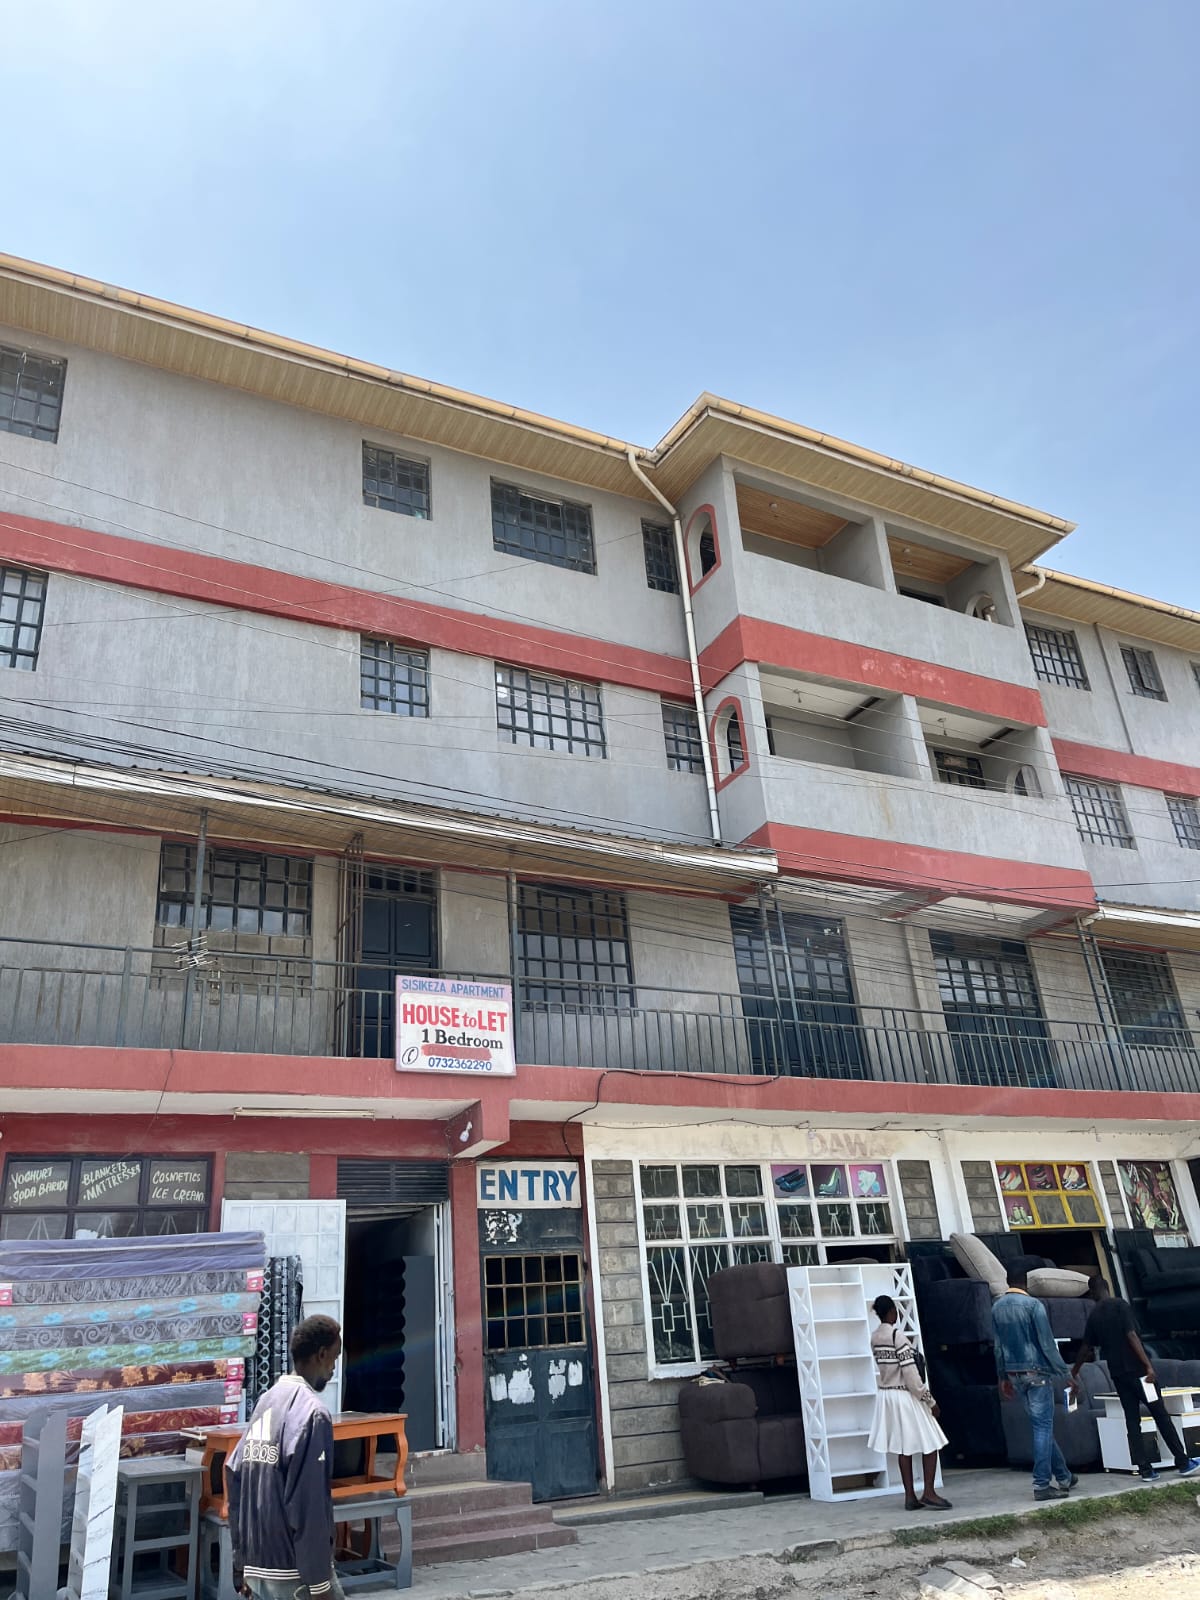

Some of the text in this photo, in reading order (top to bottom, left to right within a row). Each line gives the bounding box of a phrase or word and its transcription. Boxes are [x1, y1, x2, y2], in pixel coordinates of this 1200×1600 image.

[402, 979, 504, 998] SISIKEZA APARTMENT
[403, 1003, 507, 1032] HOUSE to LET
[422, 1029, 503, 1049] 1 Bedroom
[428, 1057, 492, 1071] 0732362290
[11, 1167, 53, 1189] YOGHURT
[83, 1162, 127, 1186] BLANKETS
[152, 1170, 201, 1184] COSMETICS
[152, 1187, 205, 1202] ICE CREAM
[480, 1169, 577, 1201] ENTRY
[13, 1187, 37, 1205] SODA
